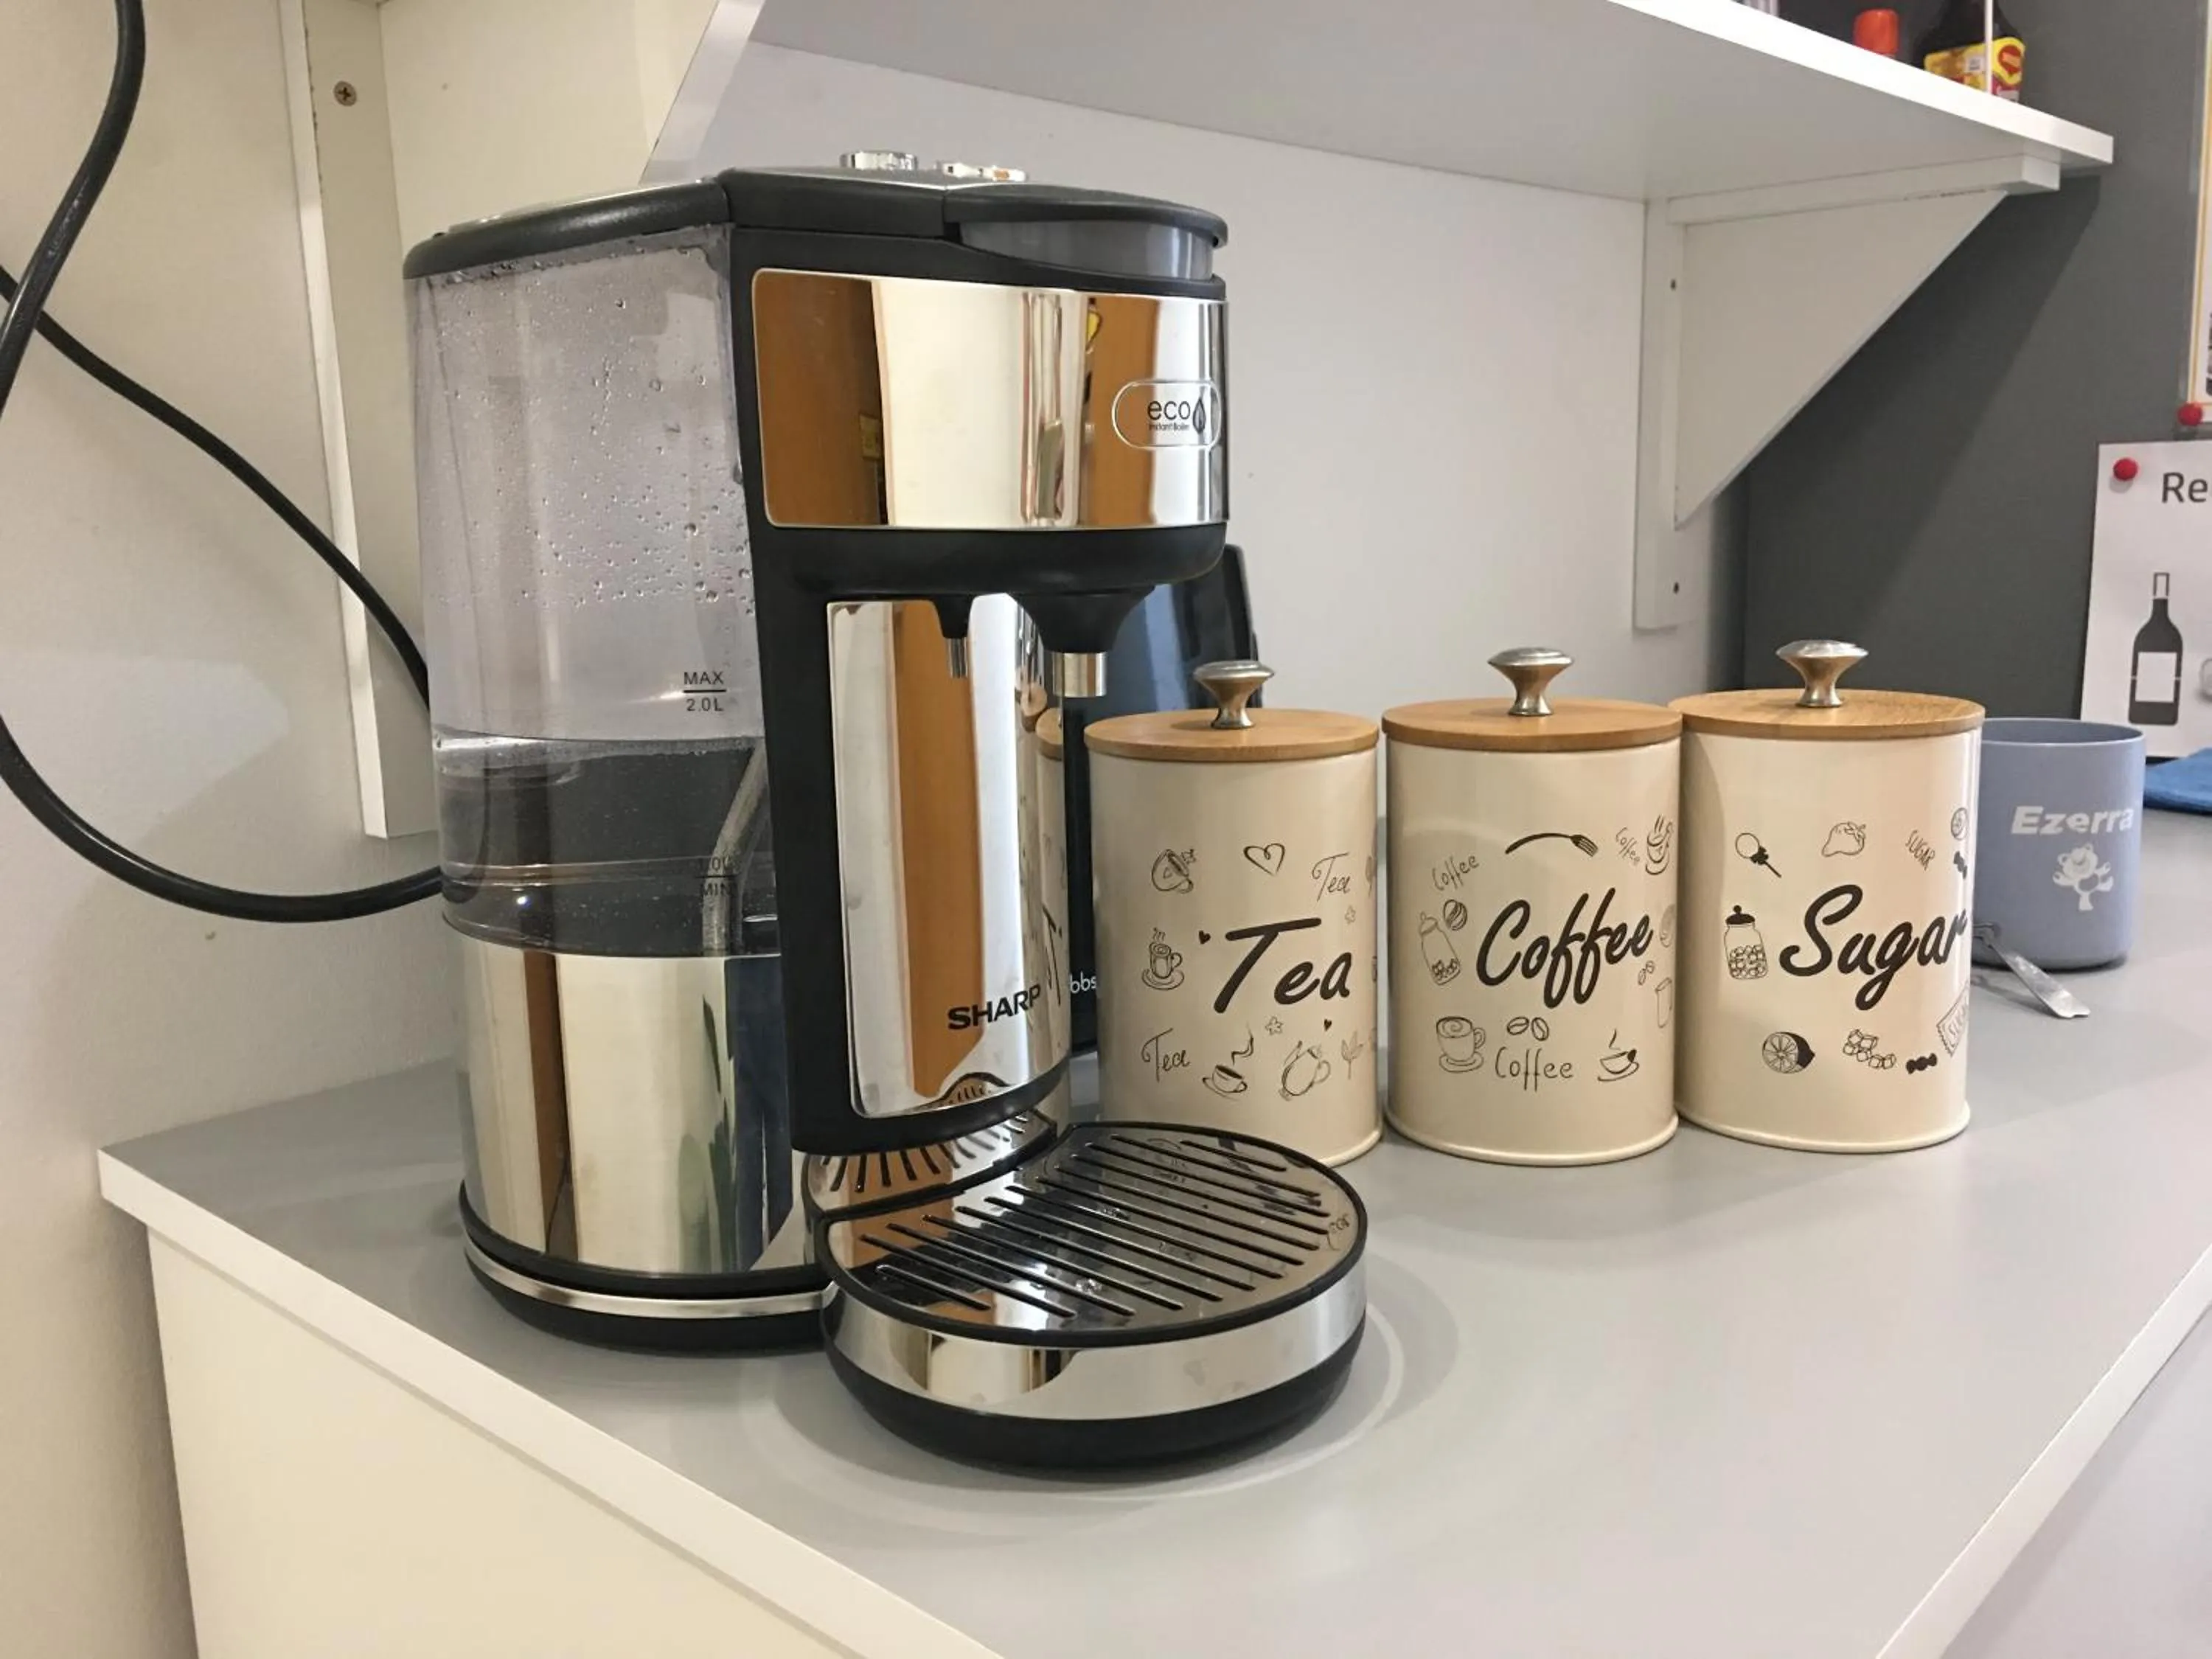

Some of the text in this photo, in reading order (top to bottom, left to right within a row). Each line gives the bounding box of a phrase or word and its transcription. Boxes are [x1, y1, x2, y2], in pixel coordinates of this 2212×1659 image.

[1147, 400, 1191, 420] eco
[2162, 472, 2210, 504] Re
[684, 671, 725, 685] MAX
[686, 697, 725, 712] 2.0L
[2011, 805, 2135, 835] Ezerra
[1311, 852, 1352, 902] Tea
[1431, 854, 1480, 891] Coffee
[1213, 917, 1352, 1014] Tea
[1475, 887, 1654, 1009] Coffee
[1778, 883, 1968, 1011] Sugar
[1069, 970, 1096, 994] bbs
[947, 984, 1042, 1031] SHARP
[1141, 1027, 1192, 1083] Tea
[1495, 1046, 1575, 1093] Coffee
